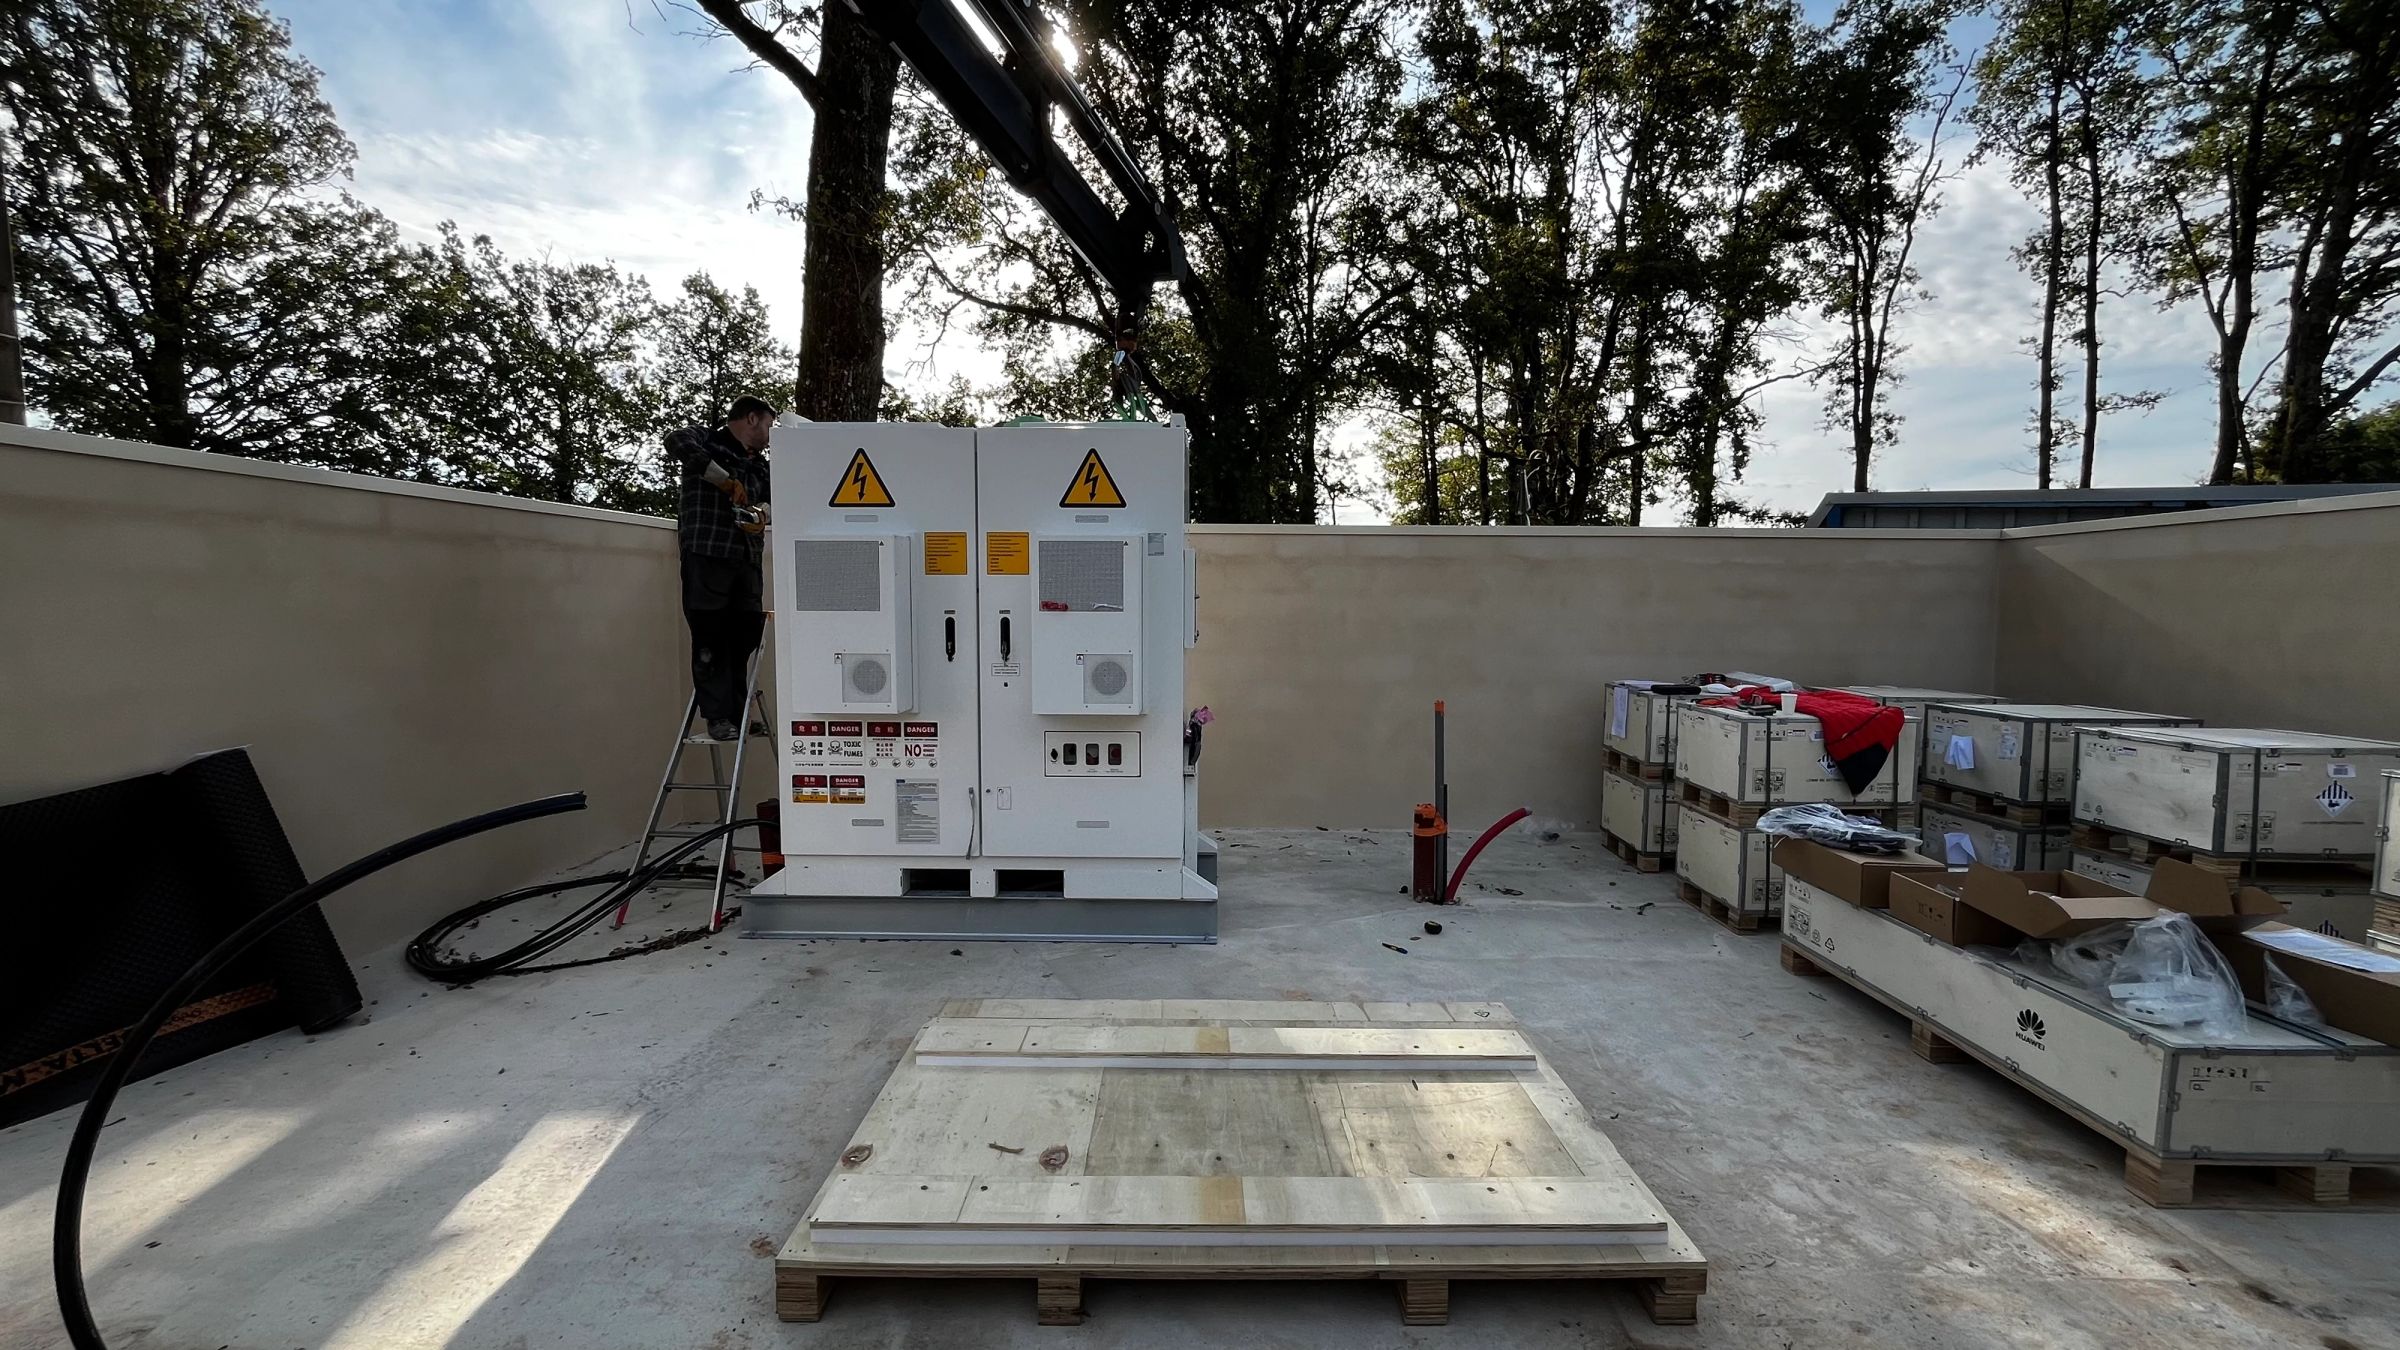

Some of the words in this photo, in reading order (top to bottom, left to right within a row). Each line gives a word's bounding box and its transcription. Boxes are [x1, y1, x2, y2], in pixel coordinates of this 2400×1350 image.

[843, 740, 862, 748] TOXIC
[904, 743, 922, 757] NO
[2015, 1031, 2046, 1051] HUAWEI
